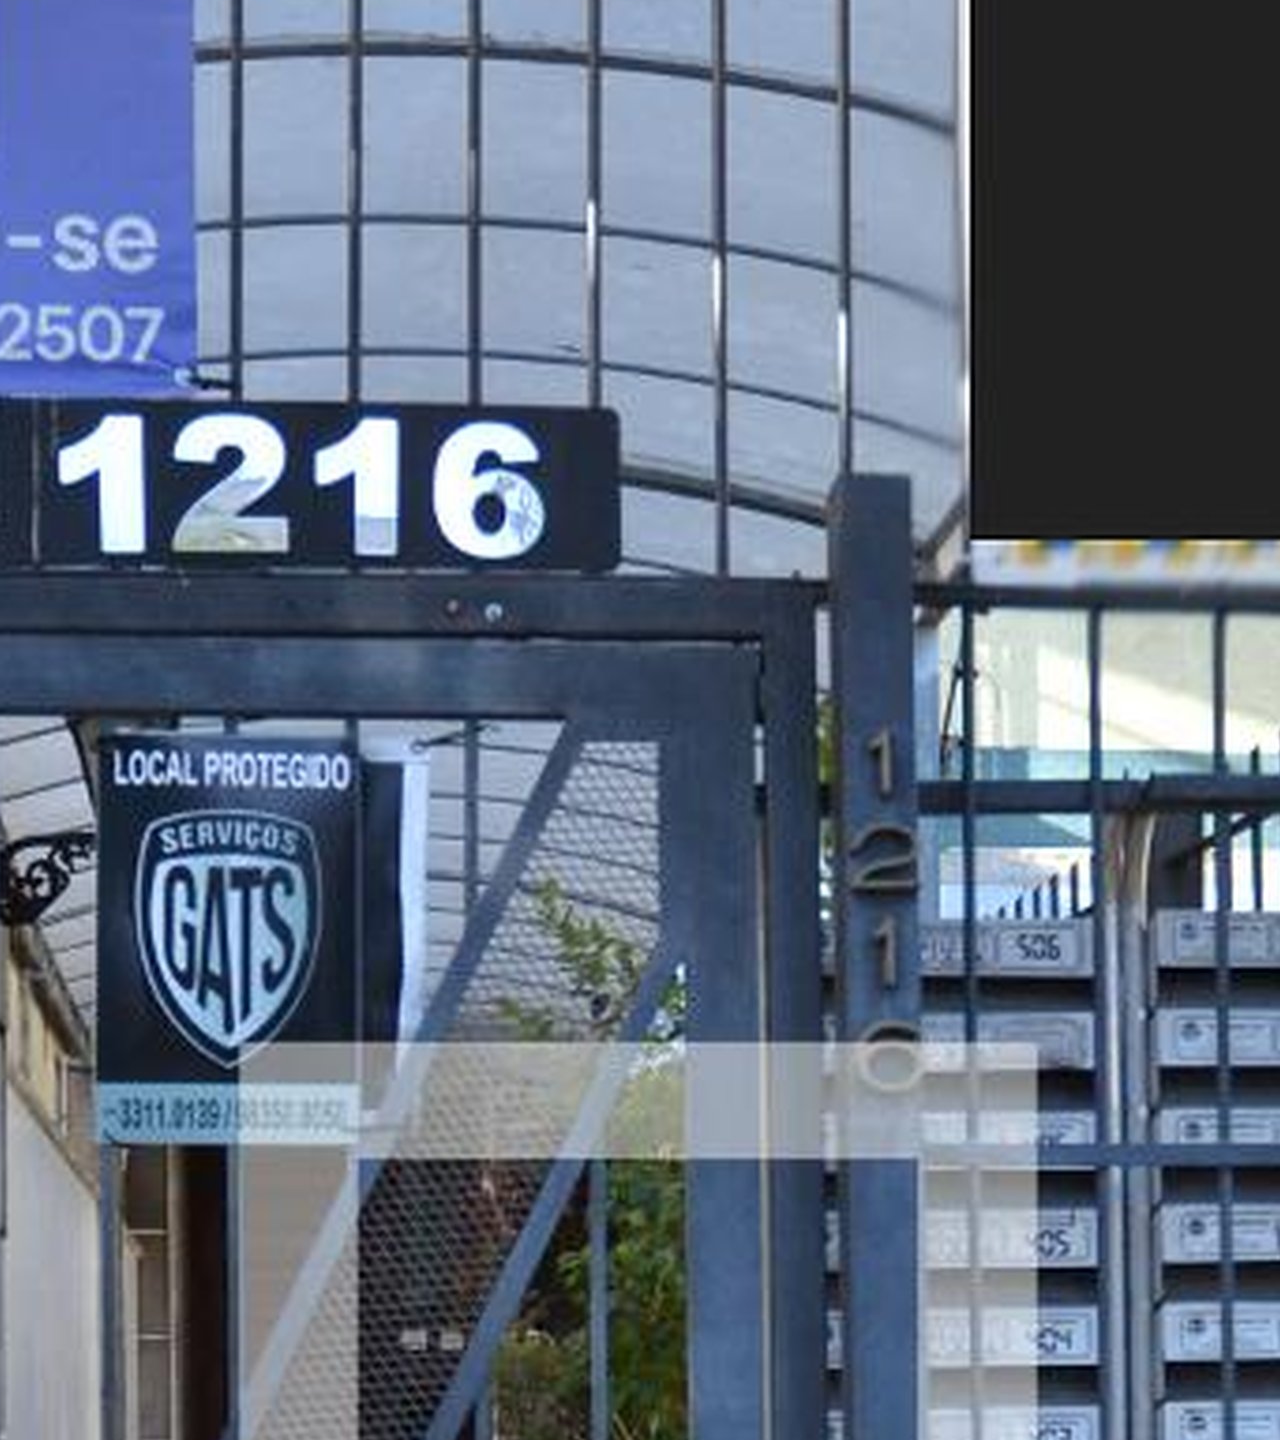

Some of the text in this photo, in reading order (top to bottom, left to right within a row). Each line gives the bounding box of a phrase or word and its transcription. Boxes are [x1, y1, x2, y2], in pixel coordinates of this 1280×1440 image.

[58, 413, 547, 558] 1216
[114, 749, 351, 790] LOCAL PROTEGIDO
[163, 865, 296, 1035] GATS
[1016, 933, 1061, 960] 506
